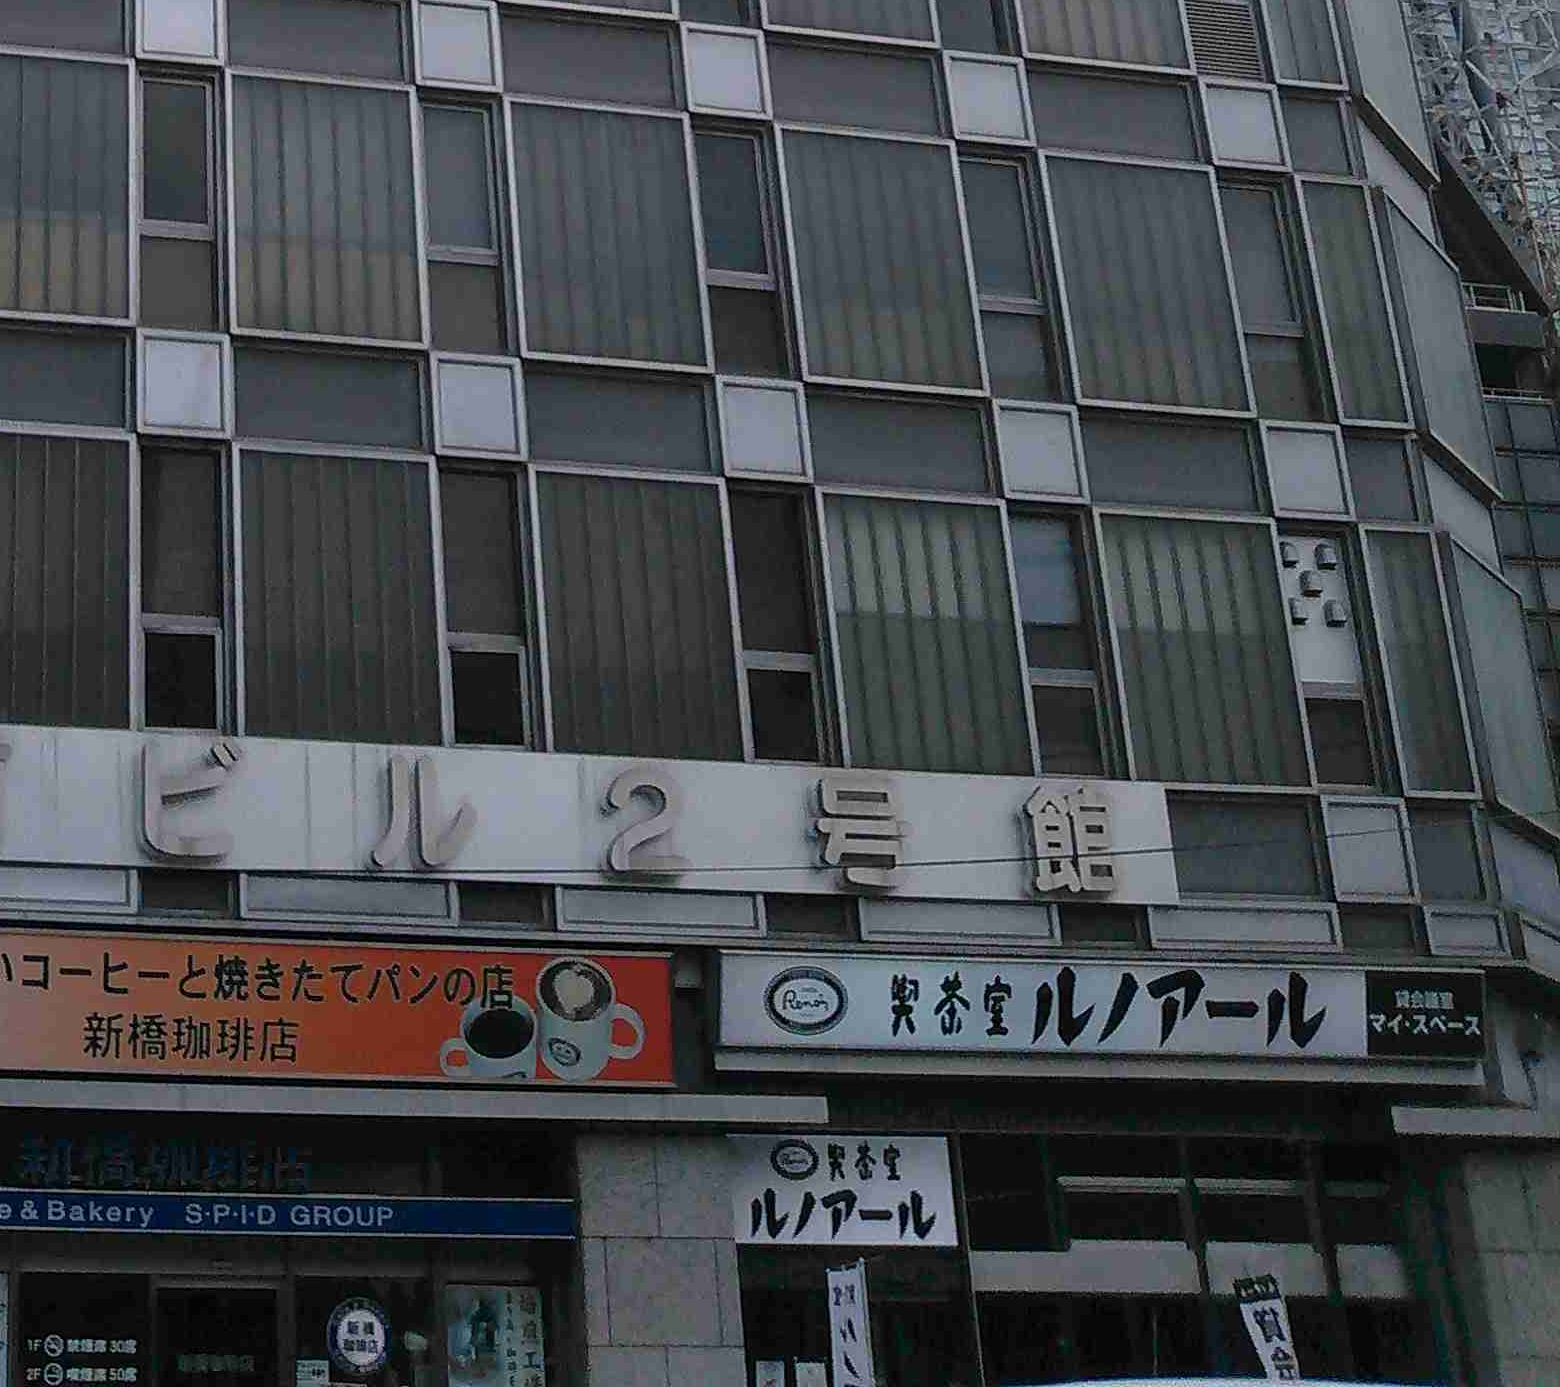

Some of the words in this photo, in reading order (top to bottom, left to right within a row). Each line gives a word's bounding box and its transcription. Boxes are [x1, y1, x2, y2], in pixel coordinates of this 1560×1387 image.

[1031, 966, 1328, 1049] ルノアール
[82, 1012, 300, 1064] 新橋珈琲店
[20, 1199, 40, 1222] &
[47, 1199, 155, 1228] Bakery
[289, 1204, 395, 1228] GROUP
[751, 1187, 937, 1240] ルノアール
